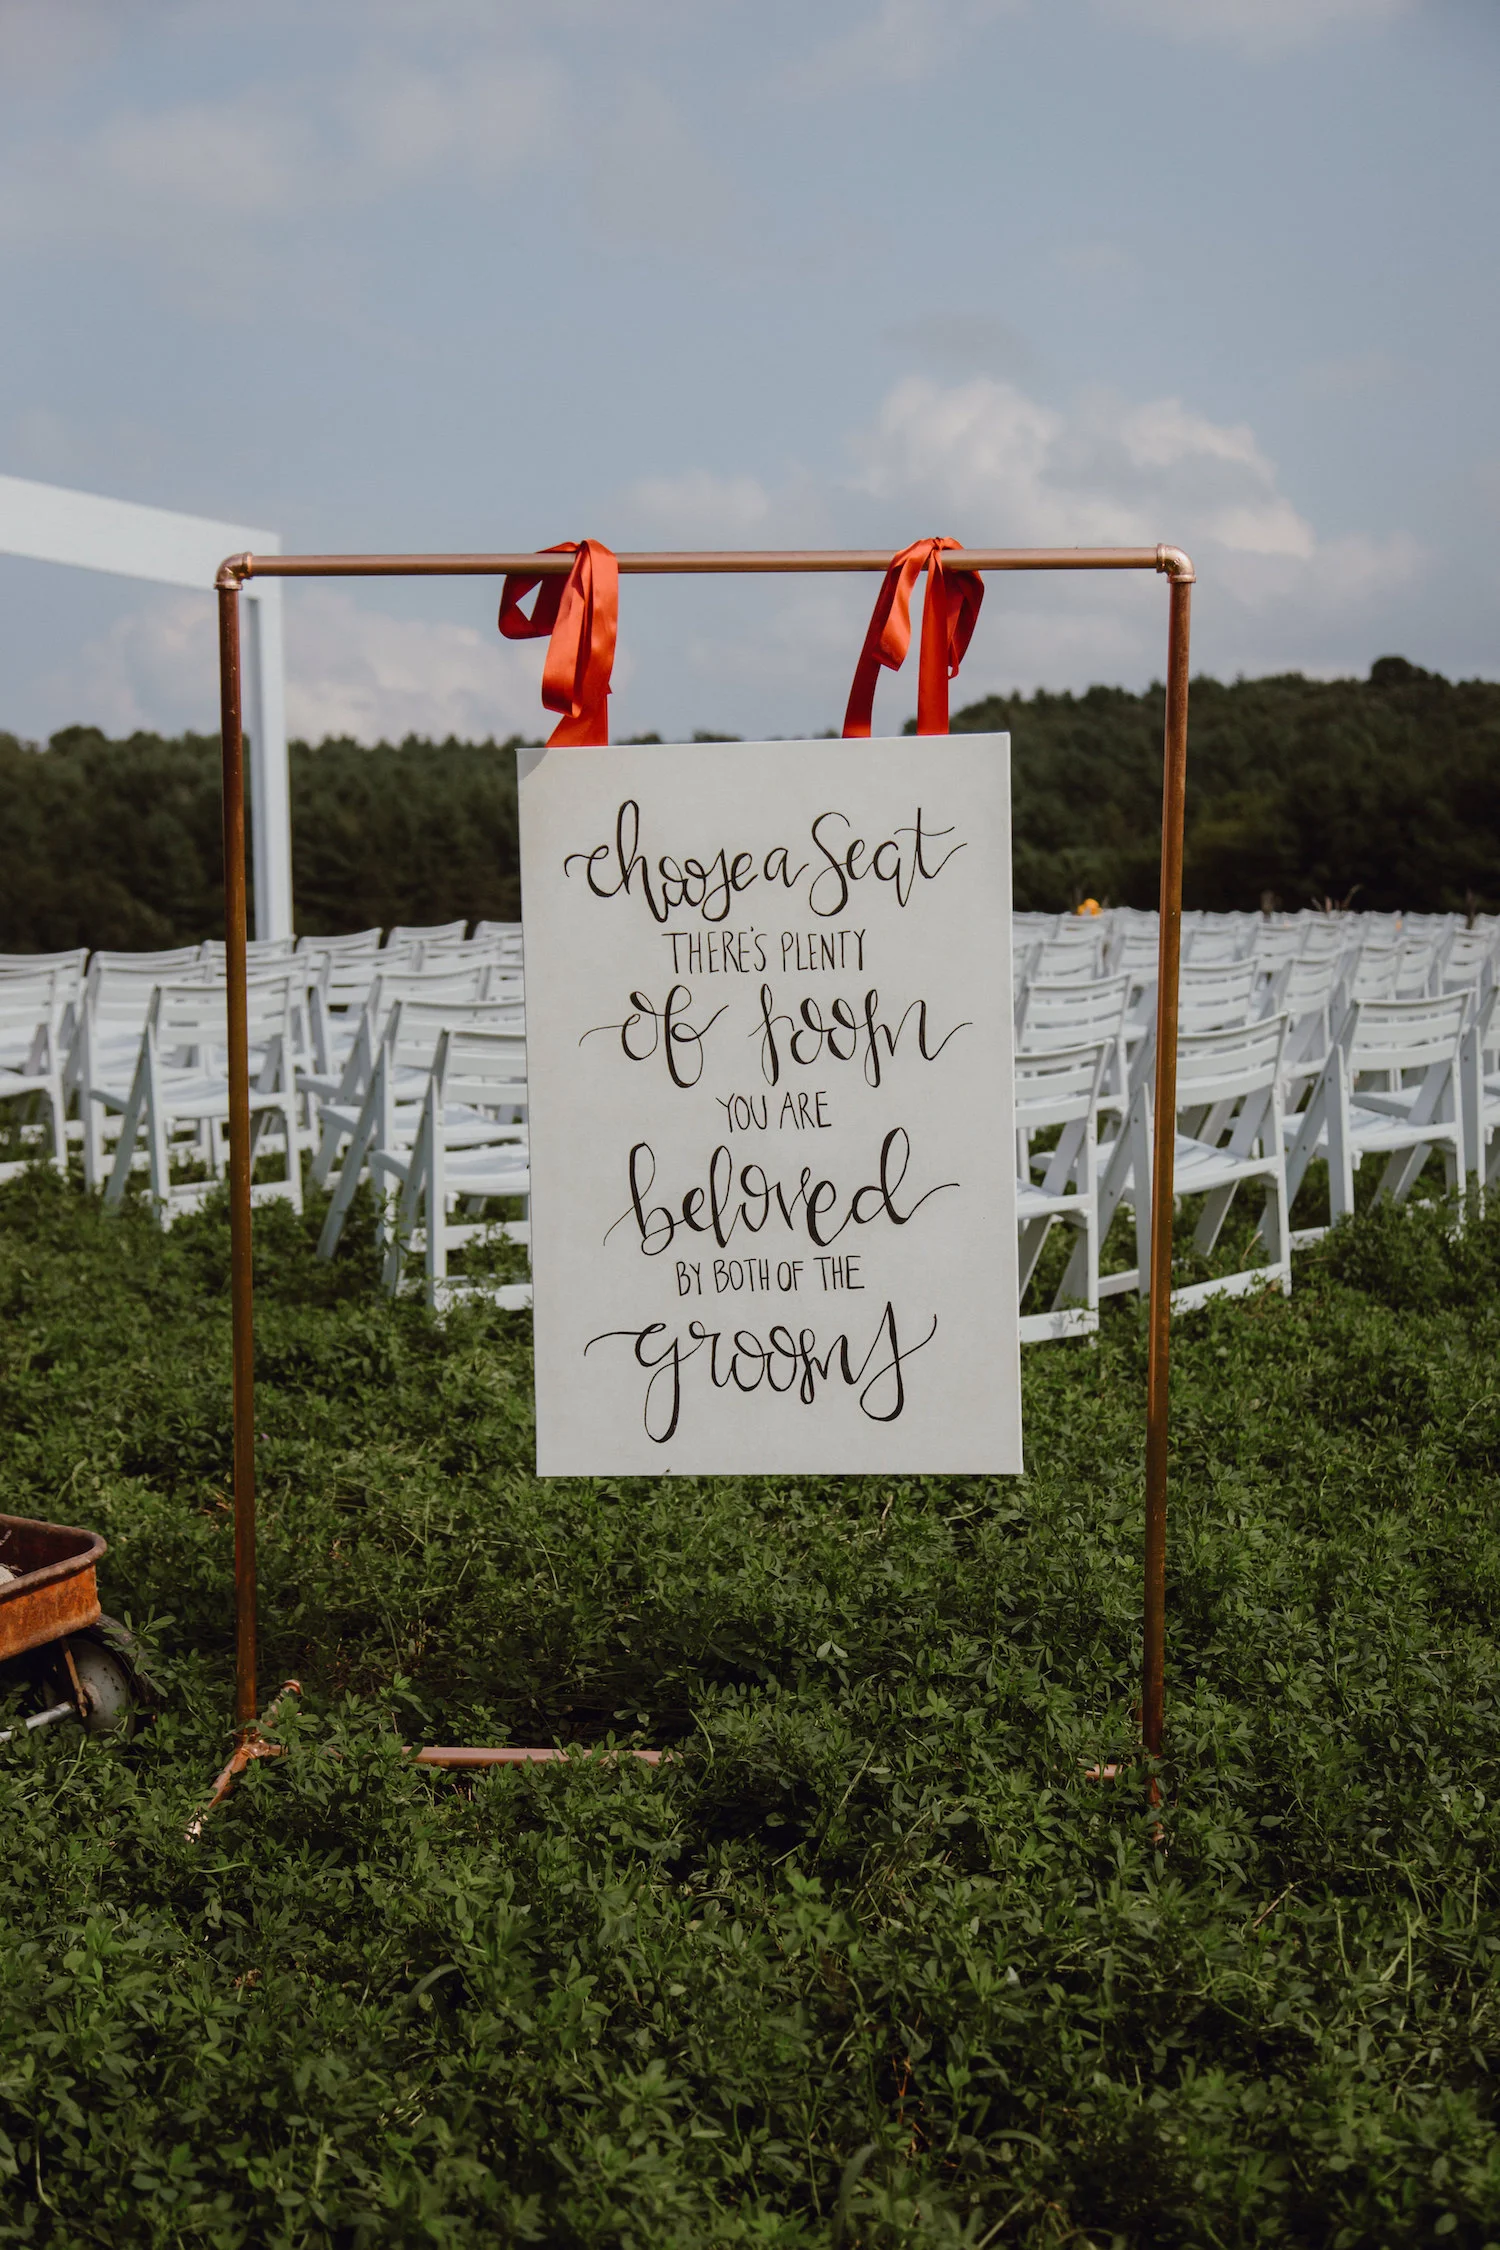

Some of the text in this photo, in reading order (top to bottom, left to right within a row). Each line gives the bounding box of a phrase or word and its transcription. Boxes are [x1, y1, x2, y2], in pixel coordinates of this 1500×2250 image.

[564, 799, 759, 923] choose
[763, 847, 811, 889] a
[661, 926, 866, 975] THERE'S PLENTY
[578, 983, 974, 1089] of room
[716, 1090, 833, 1133] YOU ARE
[603, 1126, 961, 1257] beloved
[675, 1255, 866, 1297] BY BOTH OF THE
[583, 1300, 938, 1444] grooms
